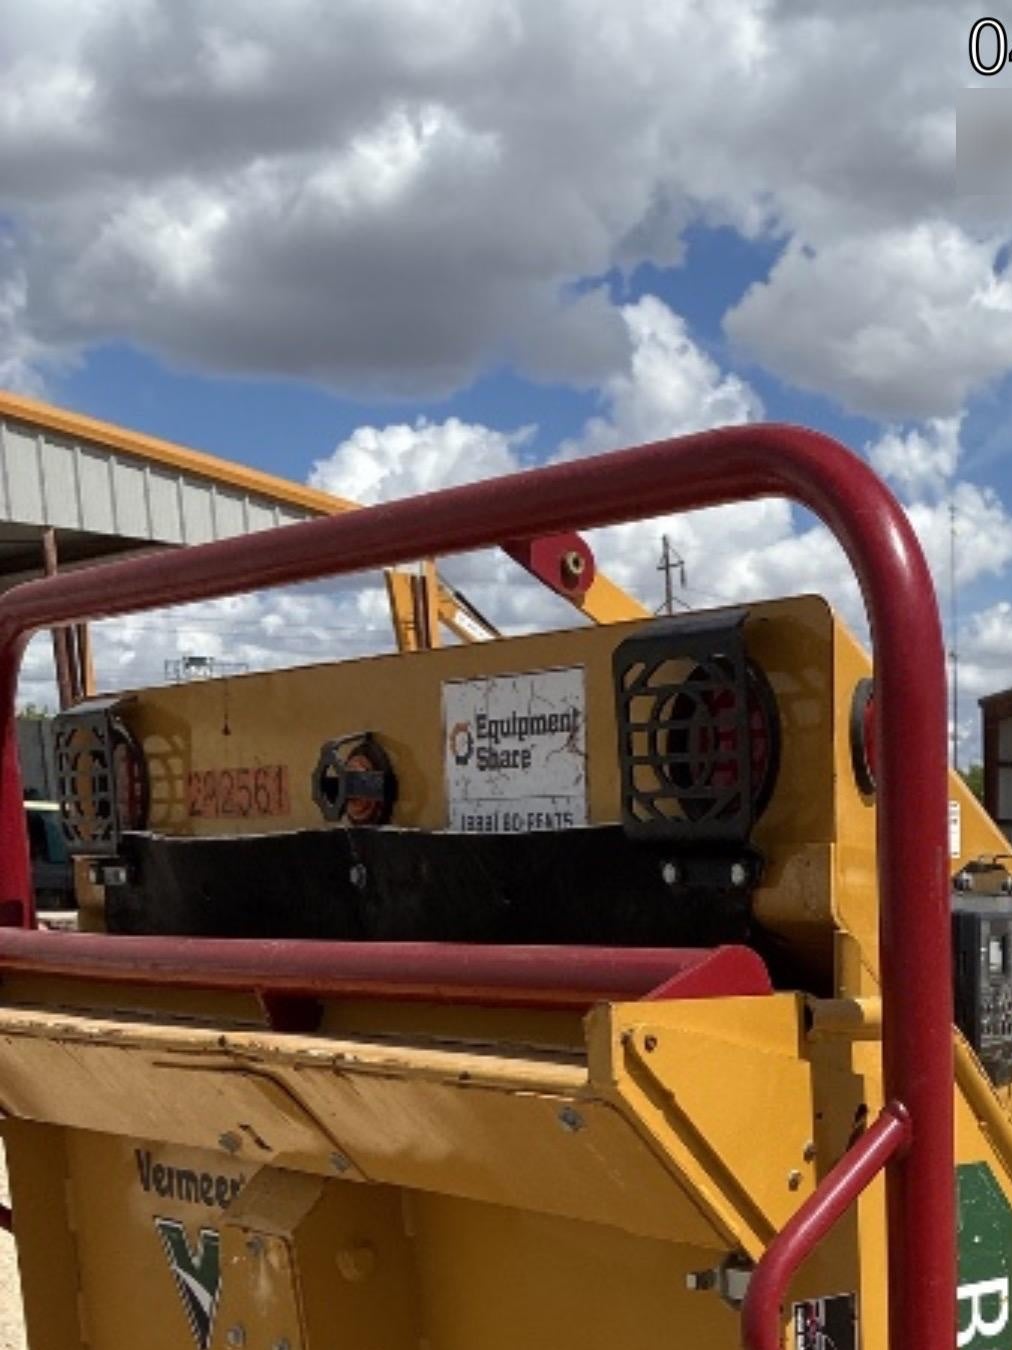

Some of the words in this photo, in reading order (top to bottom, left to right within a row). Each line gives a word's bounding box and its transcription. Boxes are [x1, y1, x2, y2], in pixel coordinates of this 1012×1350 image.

[476, 709, 579, 744] Equipment
[476, 746, 532, 772] Share
[187, 766, 283, 817] 292561
[134, 1149, 247, 1210] Vermeer
